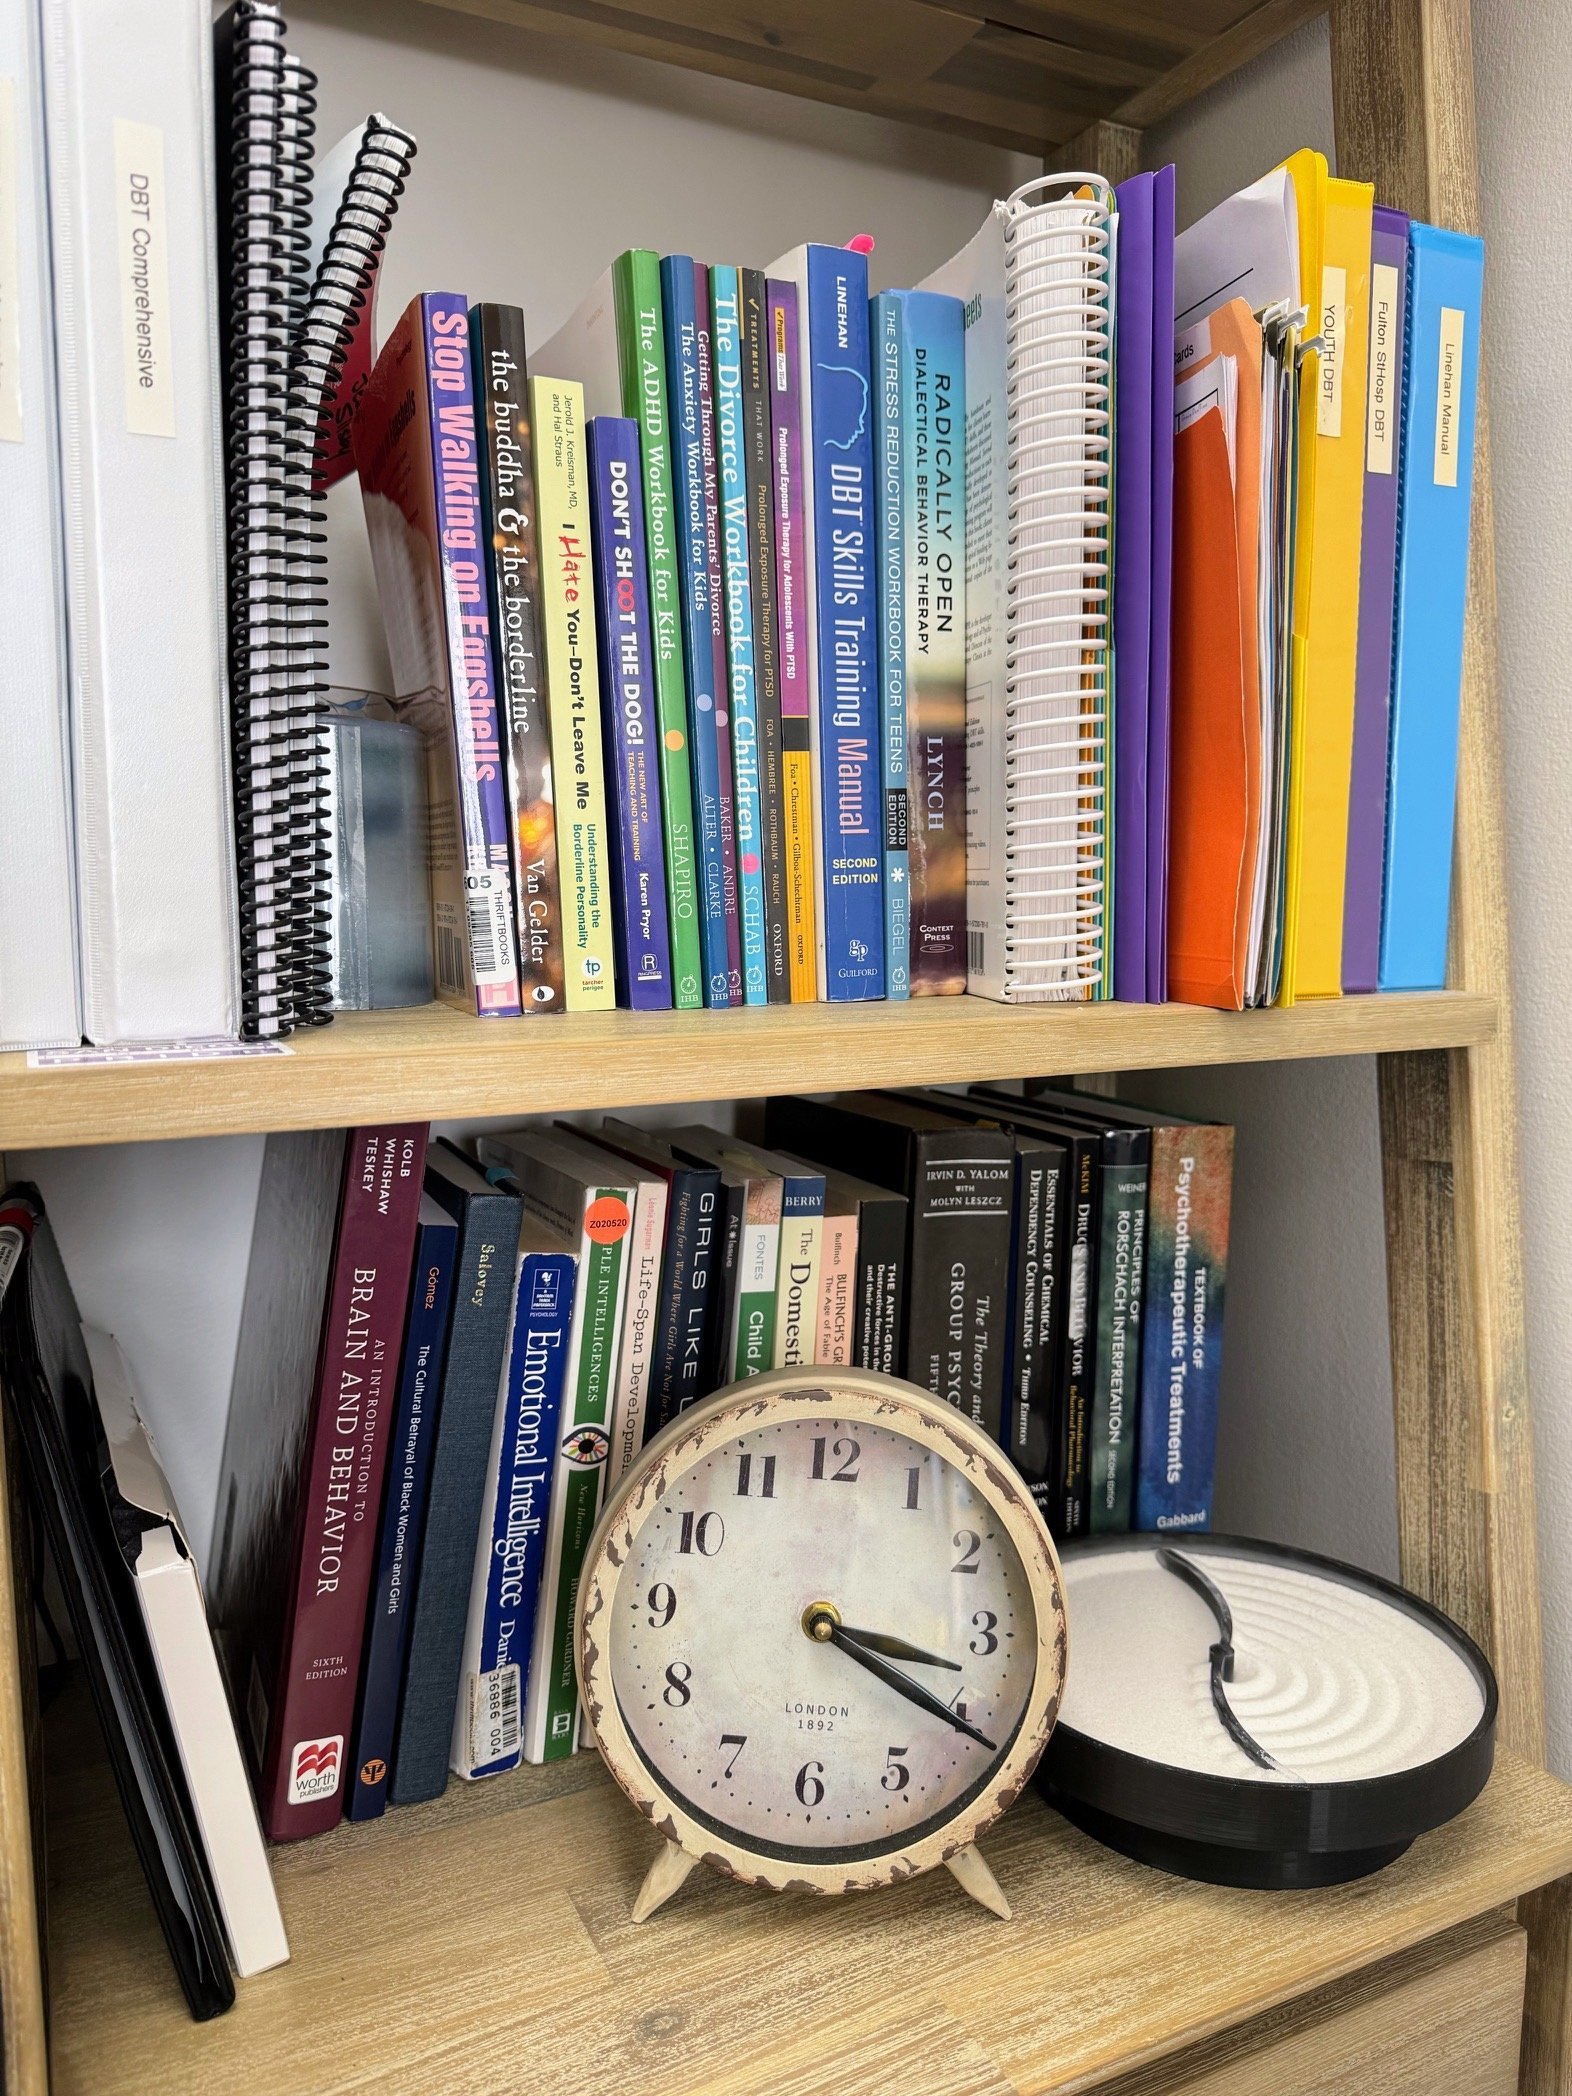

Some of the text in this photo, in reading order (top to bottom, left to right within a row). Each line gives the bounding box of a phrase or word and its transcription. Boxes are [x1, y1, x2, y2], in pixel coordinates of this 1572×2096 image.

[130, 174, 154, 388] DBT Comprehensive
[836, 277, 848, 348] LINEHAN
[432, 311, 467, 391] Stop
[698, 331, 709, 391] Getting
[1322, 305, 1336, 402] YOUTH DBT
[1374, 301, 1388, 442] Fulton StHosp DBT
[701, 397, 715, 466] Through
[1441, 344, 1455, 454] Linehan Manual
[439, 405, 478, 550] Walking
[640, 308, 675, 660] The ADHD Workbook for Kids
[682, 322, 706, 611] The Anxiety Workbook for Kids
[704, 471, 717, 499] My
[915, 349, 929, 654] DIALECTICAL BEHAVIOR THERAPY
[935, 373, 952, 632] RADICALLY OPEN
[492, 350, 536, 734] the buddha & the borderline
[715, 294, 758, 841] The Divorce Workbook for Children
[833, 530, 864, 605] Skills
[886, 309, 903, 773] THE STRESS REDUCTION WORKBOOK FOR TEENS
[451, 561, 481, 602] on
[615, 547, 636, 624] SHOOT
[710, 574, 721, 636] Divorce
[619, 633, 638, 675] THE
[833, 617, 866, 727] Training
[624, 684, 643, 744] DOG!
[790, 763, 798, 778] Foa
[838, 738, 869, 836] Manual
[926, 736, 944, 831] LYNCH
[573, 825, 586, 949] Borderline Personality
[587, 824, 600, 928] Understanding the
[673, 824, 692, 918] SHAPIRO
[705, 795, 721, 918] ALTER CLARKE
[720, 797, 735, 914] BAKER ANDRE
[793, 843, 801, 923] Gilboa-Schechtman
[832, 858, 877, 869] SECOND
[832, 874, 878, 884] EDITION
[494, 891, 509, 964] THRIFTBOOKS
[527, 860, 549, 963] Van Gelder
[639, 873, 651, 939] Karen Pryor
[744, 885, 760, 954] SCHAB
[892, 899, 904, 956] BIEGEL
[362, 1138, 378, 1192] TESKEY
[378, 1139, 397, 1214] WHISHAW
[400, 1140, 414, 1177] KOLB
[927, 1170, 1009, 1181] IRVIN D. YALOM
[590, 1219, 627, 1228] Z020520
[785, 1196, 823, 1206] BERRY
[472, 1245, 495, 1306] Salovey
[693, 1192, 715, 1289] GIRLS
[726, 1215, 739, 1268] At Issue
[755, 1235, 765, 1280] FONTES
[1130, 1210, 1144, 1324] PRINCIPLES OF
[683, 1308, 703, 1379] LIKE
[747, 1311, 764, 1359] Child
[1109, 1211, 1130, 1445] RORSCHACH INTERPRETATION
[1167, 1157, 1195, 1485] Psychotherapeutic Treatments
[1193, 1267, 1206, 1370] TEXTBOOK OF
[970, 1296, 990, 1425] The Theory and
[317, 1268, 377, 1595] BRAIN AND BEHAVIOR
[354, 1340, 385, 1522] AN INTRODUCTION TO
[513, 1329, 561, 1467] Emotional
[388, 1346, 430, 1614] The Cultural Betrayal of Black Women and Girls
[733, 1454, 777, 1499] 11
[807, 1437, 861, 1482] 12
[901, 1467, 922, 1510] 1
[495, 1474, 545, 1608] Intelligence
[675, 1511, 725, 1556] 10
[950, 1530, 982, 1574] 2
[1157, 1510, 1205, 1529] Gabbard
[648, 1583, 676, 1628] 9
[969, 1611, 998, 1655] 3
[306, 1667, 347, 1680] EDITION
[313, 1656, 343, 1667] SIXTH
[663, 1662, 692, 1707] 8
[488, 1674, 501, 1756] 36886 004
[785, 1704, 850, 1717] LONDON
[798, 1720, 835, 1731] 1892
[296, 1772, 335, 1791] worth
[300, 1785, 334, 1798] publishers
[719, 1735, 747, 1778] 7
[795, 1761, 824, 1806] 6
[881, 1747, 910, 1792] 5
